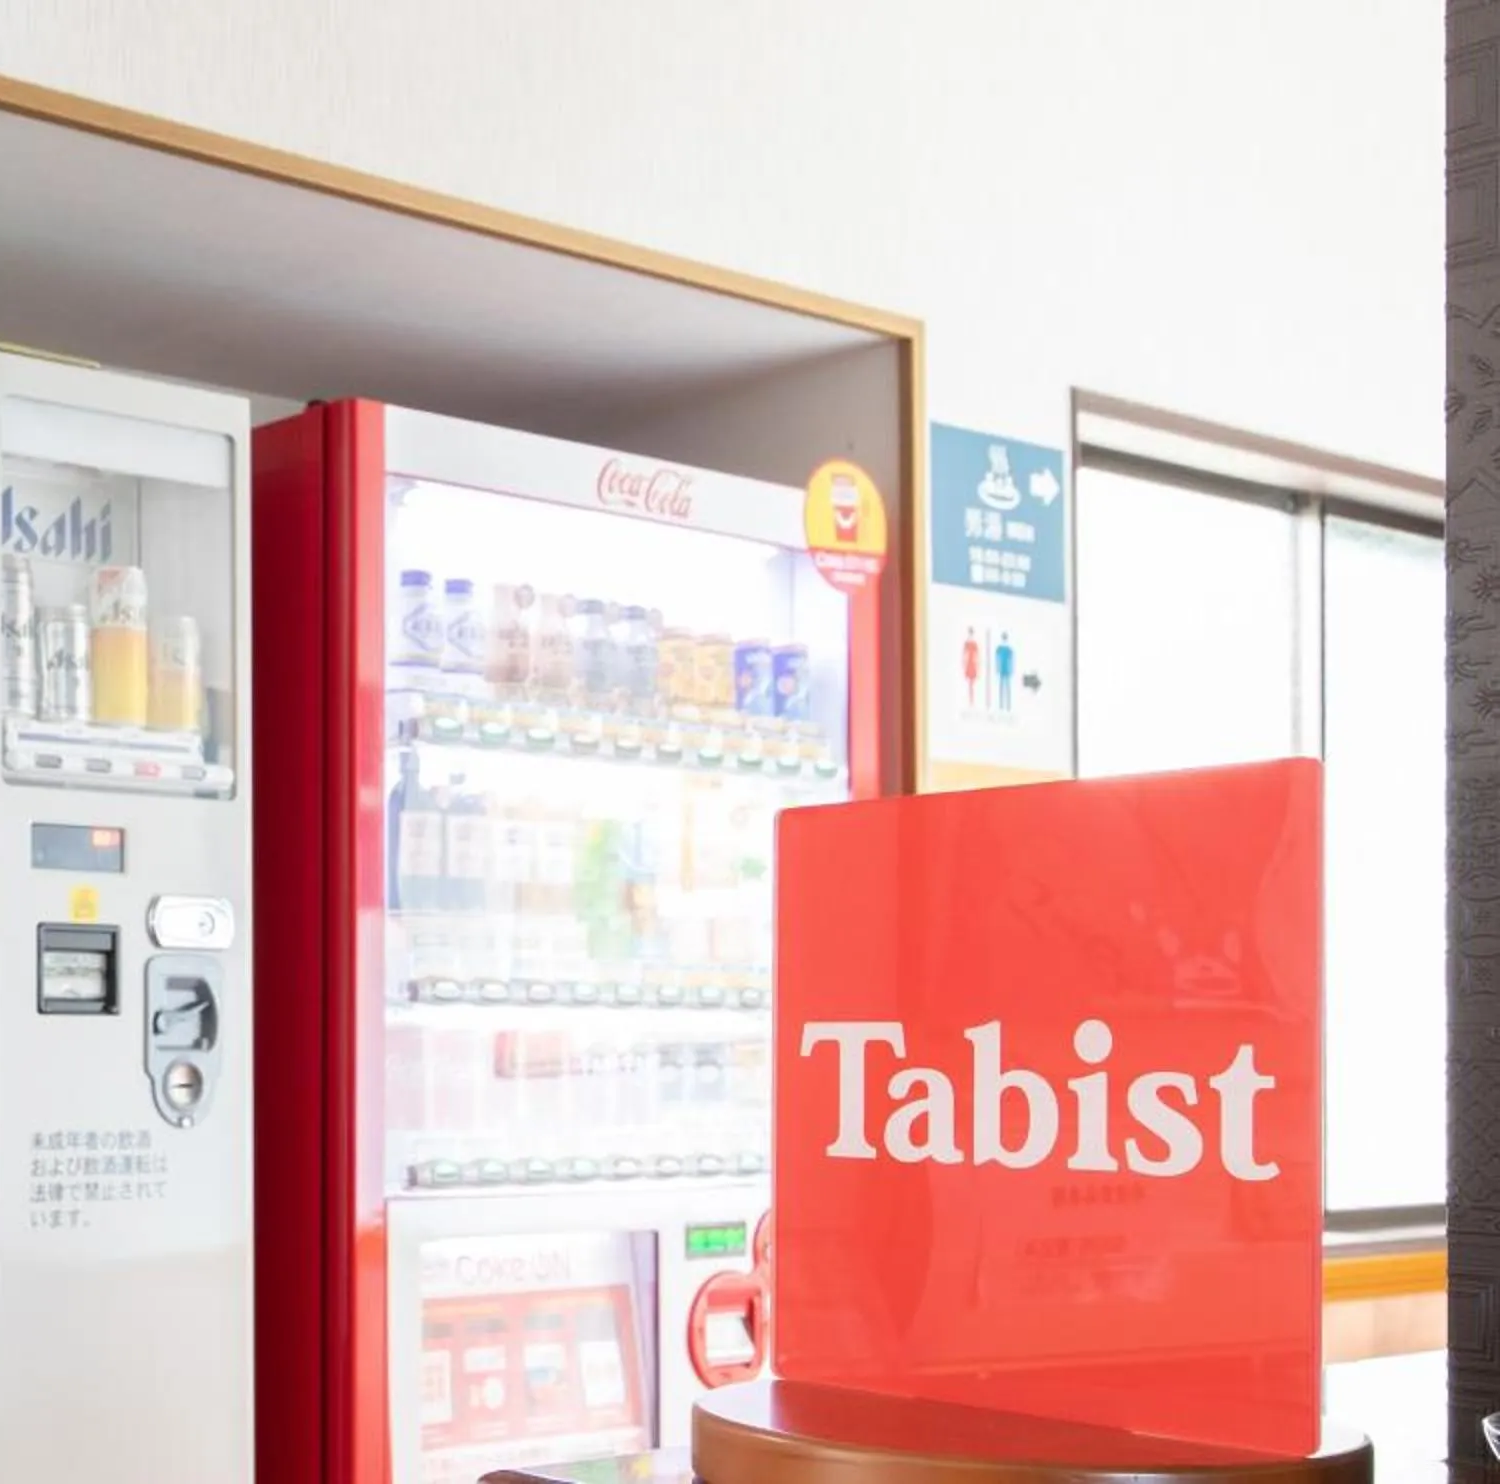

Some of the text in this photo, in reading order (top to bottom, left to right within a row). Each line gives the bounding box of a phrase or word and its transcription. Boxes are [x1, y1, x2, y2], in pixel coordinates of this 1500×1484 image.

[596, 458, 693, 518] Coca-Cola
[800, 1019, 1281, 1182] Tabist
[30, 1128, 152, 1151] 未成年者の飲酒
[30, 1151, 169, 1177] および飲酒運転は
[29, 1181, 168, 1204] 法律で禁止されて
[30, 1208, 92, 1230] います。
